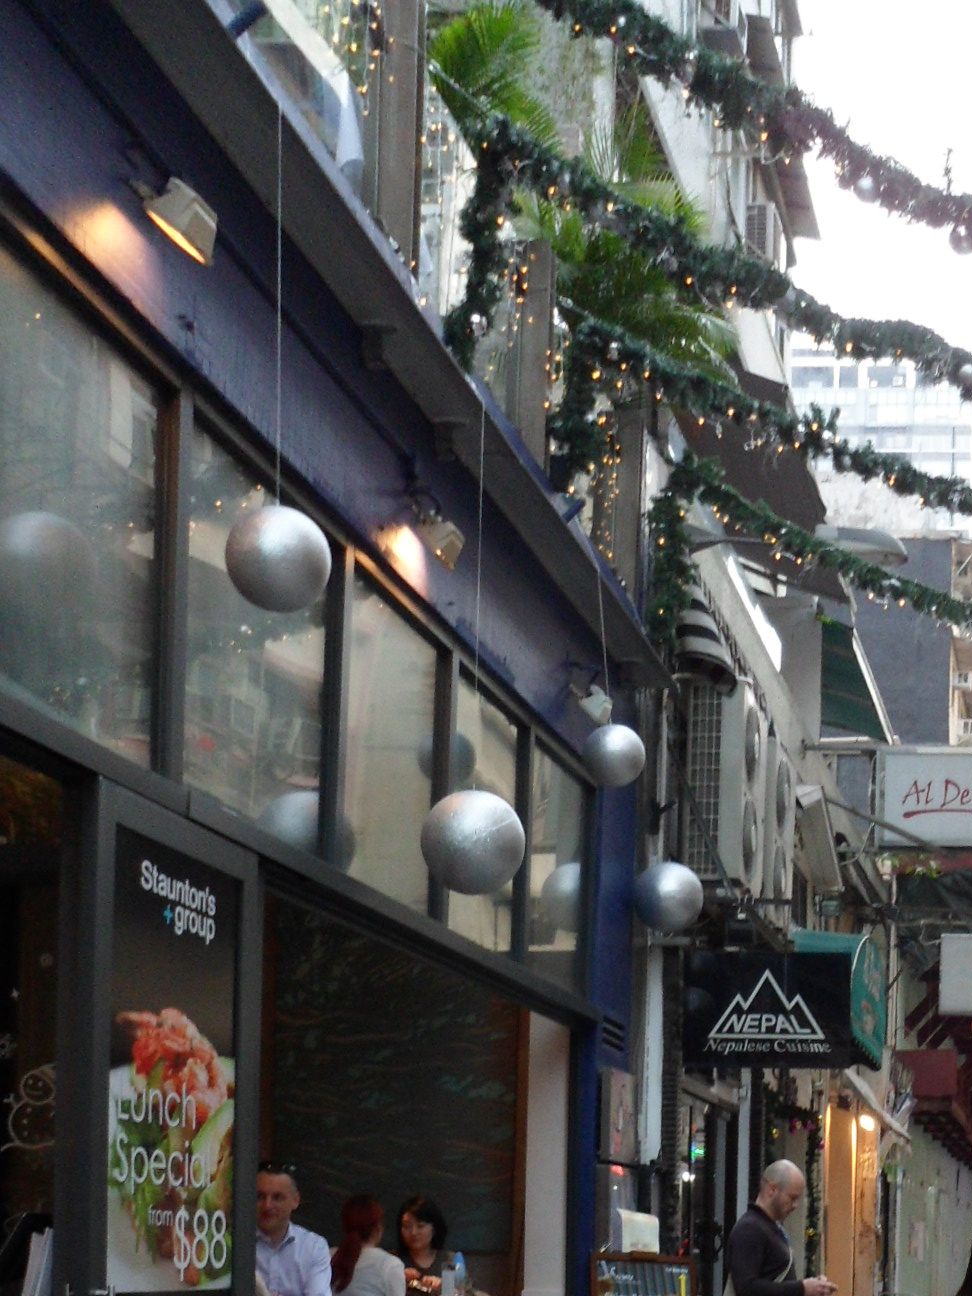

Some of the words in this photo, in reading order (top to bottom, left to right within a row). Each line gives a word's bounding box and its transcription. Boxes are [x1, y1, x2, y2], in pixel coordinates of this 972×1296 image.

[901, 779, 933, 807] Al
[141, 859, 217, 917] Staunton's
[704, 1038, 772, 1056] Nepalese
[773, 1040, 833, 1054] Cuisine
[721, 1013, 813, 1034] NEPAL
[117, 1082, 197, 1131] Lunch
[112, 1131, 212, 1195] Special
[148, 1204, 174, 1226] from
[173, 1204, 228, 1282] $88
